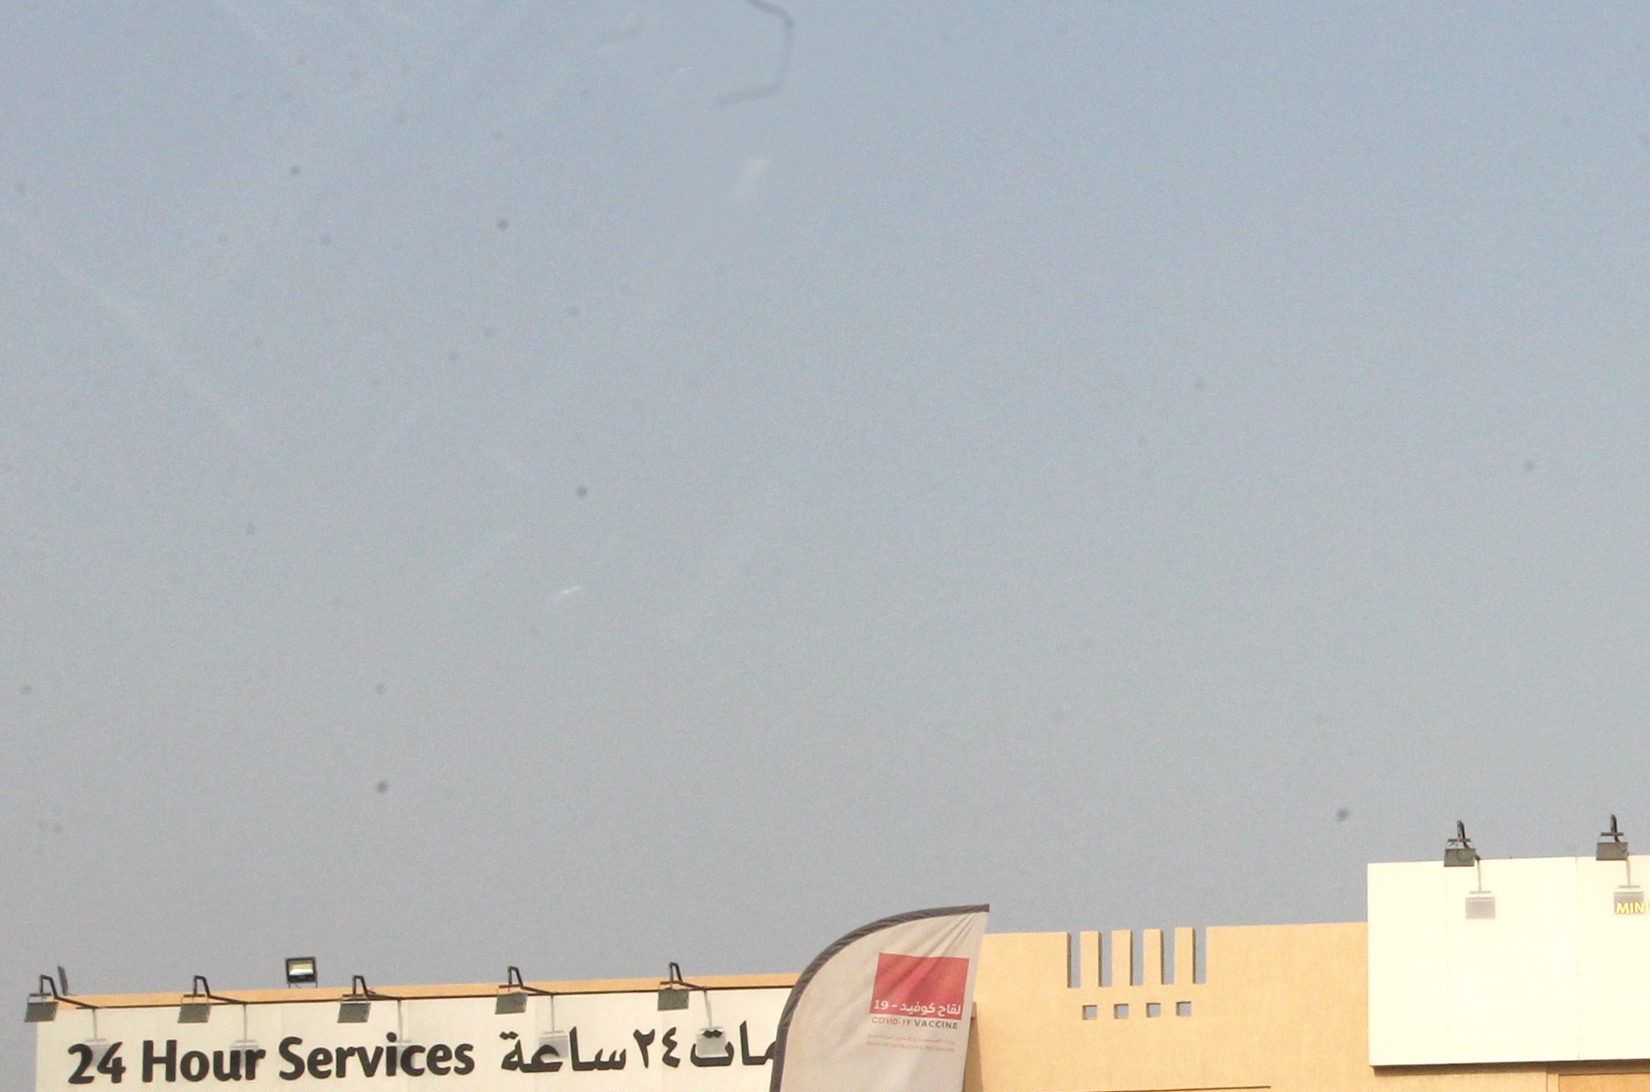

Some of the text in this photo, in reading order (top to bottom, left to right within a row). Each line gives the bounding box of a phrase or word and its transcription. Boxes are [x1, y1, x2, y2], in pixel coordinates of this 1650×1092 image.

[873, 999, 890, 1011] 19
[900, 1001, 937, 1016] كوفيد
[937, 1003, 962, 1017] لقاح
[914, 1019, 958, 1029] VACCINE
[499, 1026, 627, 1073] ساعة
[67, 1031, 475, 1085] 24 Hour Services
